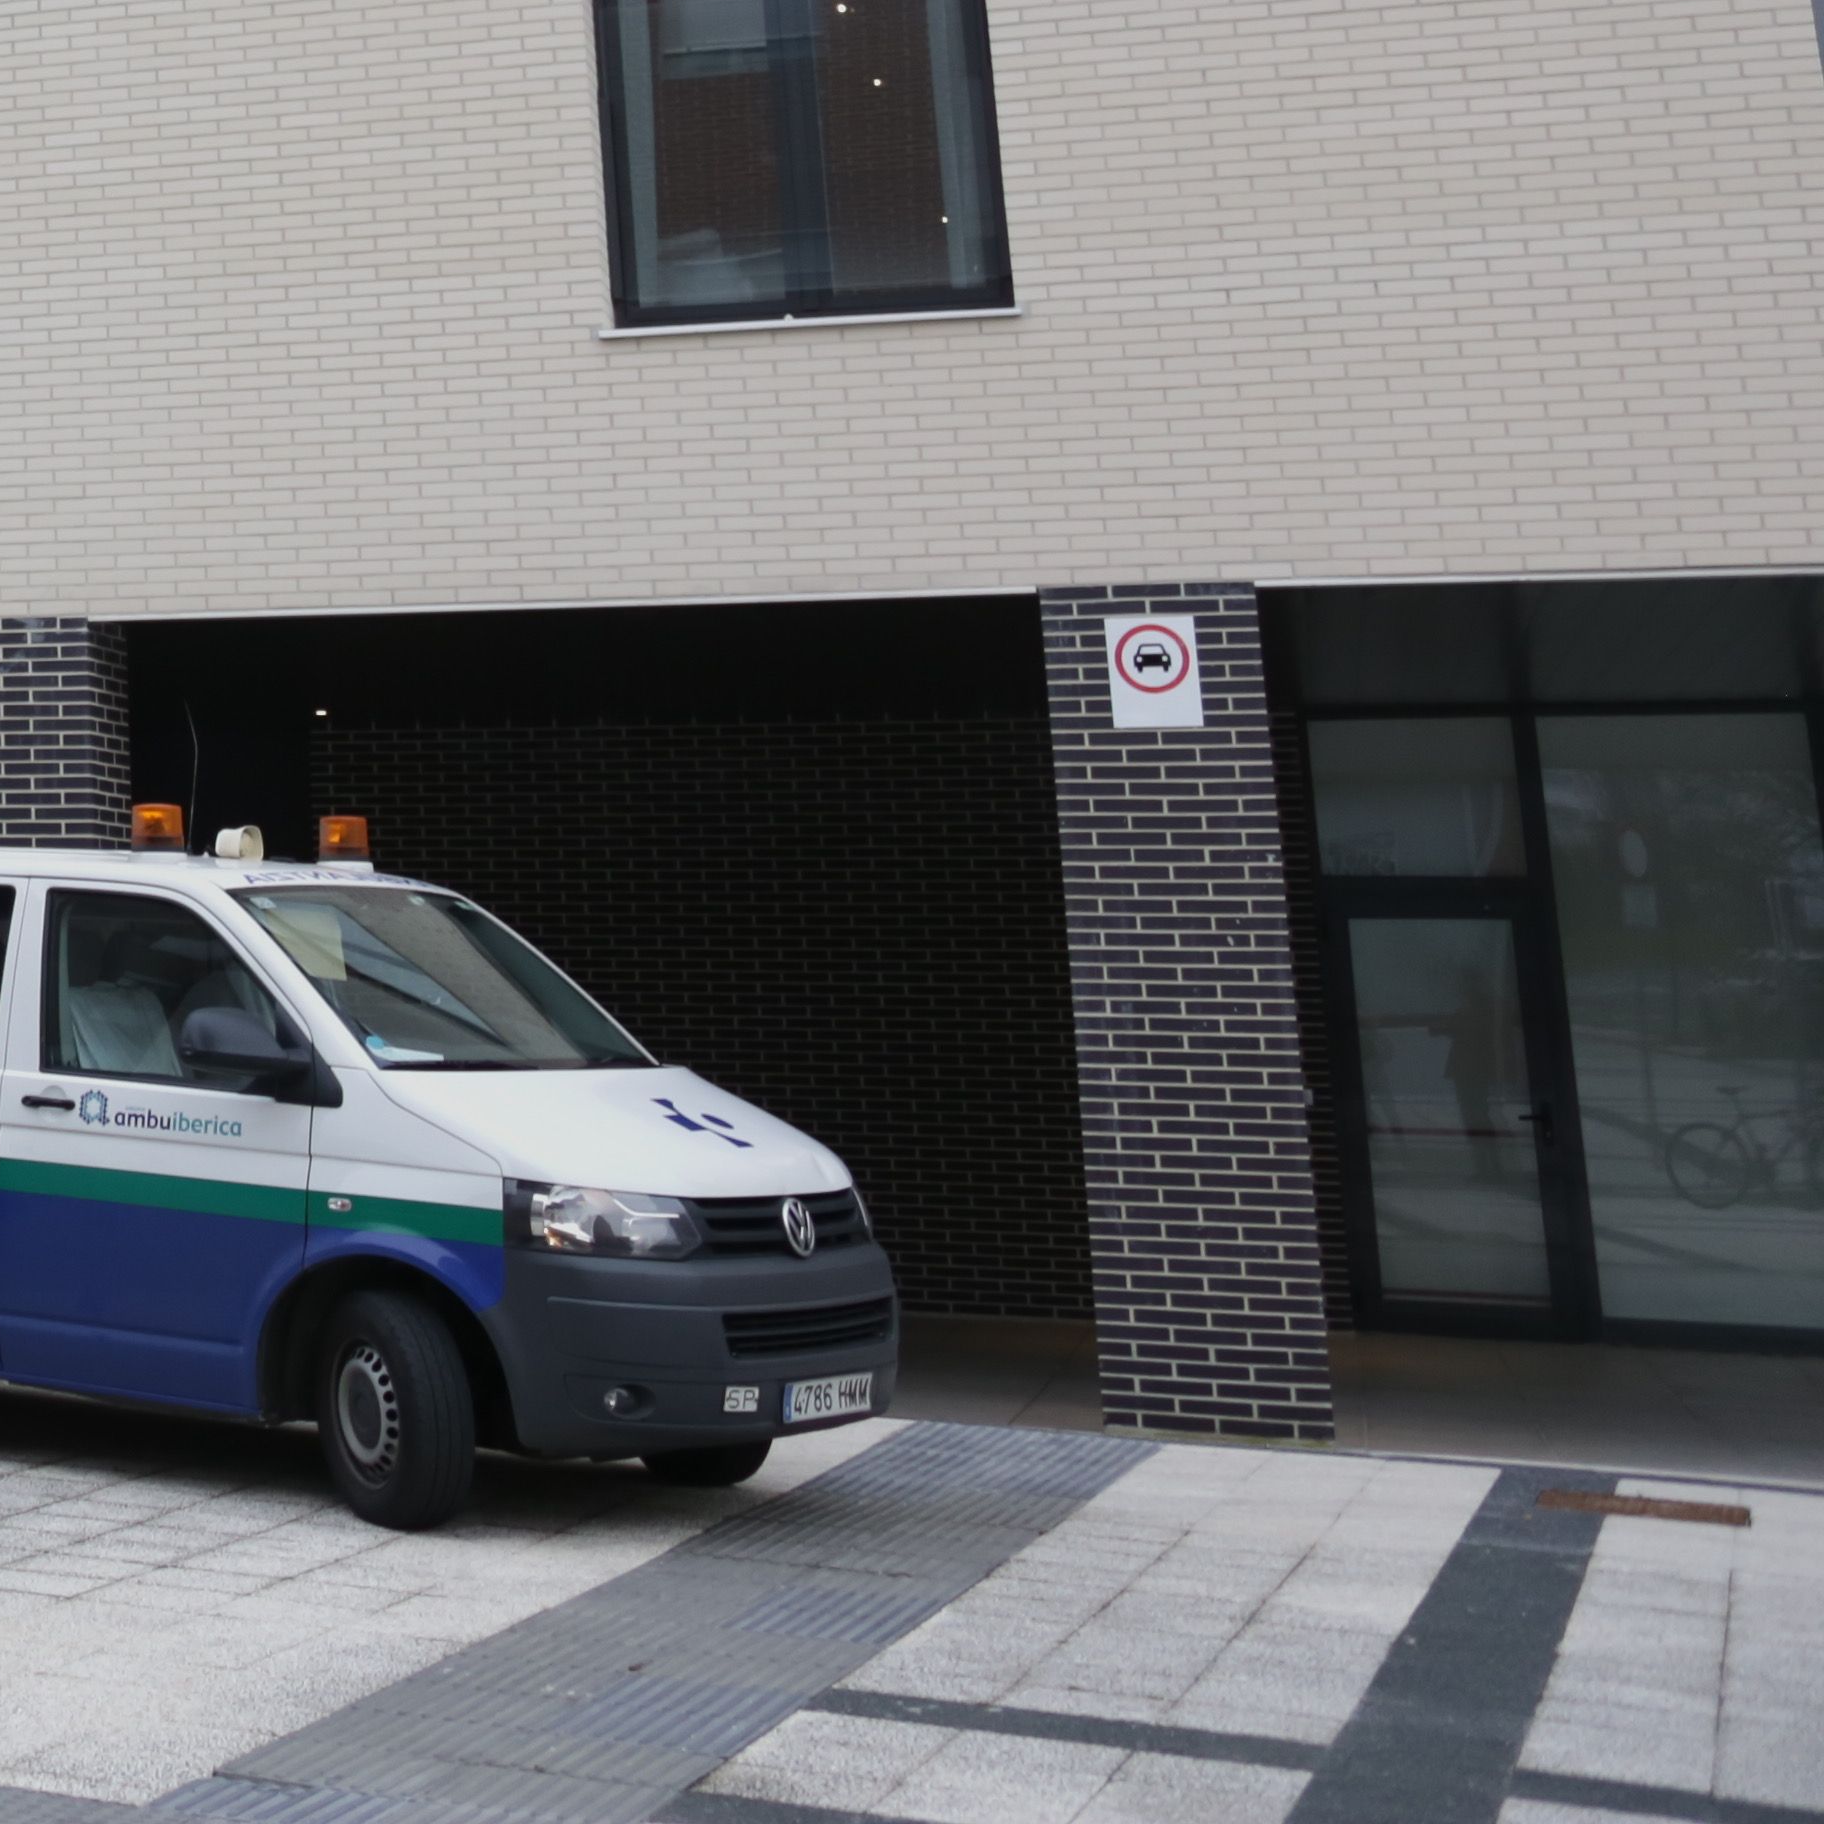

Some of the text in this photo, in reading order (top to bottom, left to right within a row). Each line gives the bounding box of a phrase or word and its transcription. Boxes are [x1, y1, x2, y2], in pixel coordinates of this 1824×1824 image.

[114, 1108, 242, 1137] ambuiberica
[793, 1377, 870, 1416] 4786 HMM
